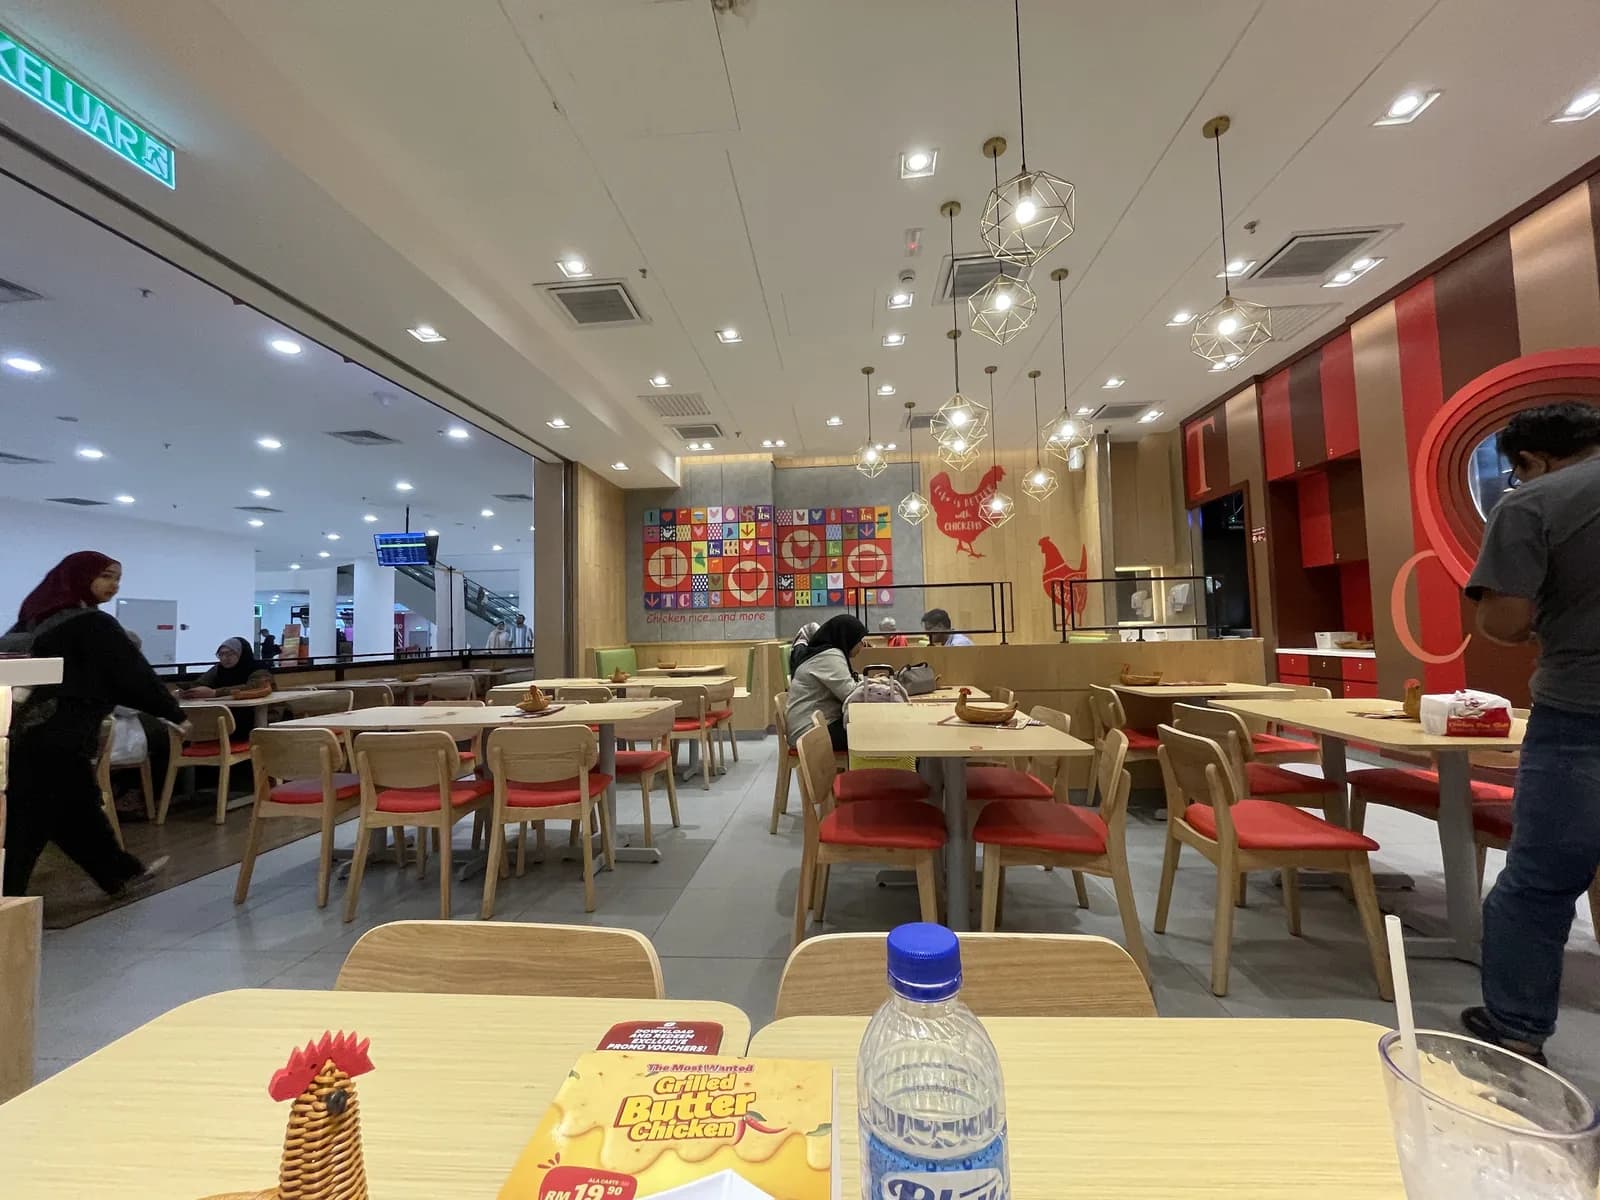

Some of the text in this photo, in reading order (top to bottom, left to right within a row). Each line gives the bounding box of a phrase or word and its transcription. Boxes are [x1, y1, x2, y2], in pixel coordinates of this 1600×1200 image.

[647, 1044, 708, 1052] VOUCHERS!
[647, 1064, 755, 1073] The Most Wanted
[654, 1073, 737, 1094] Grilled
[616, 1091, 756, 1127] Butter
[629, 1119, 736, 1141] Chicken
